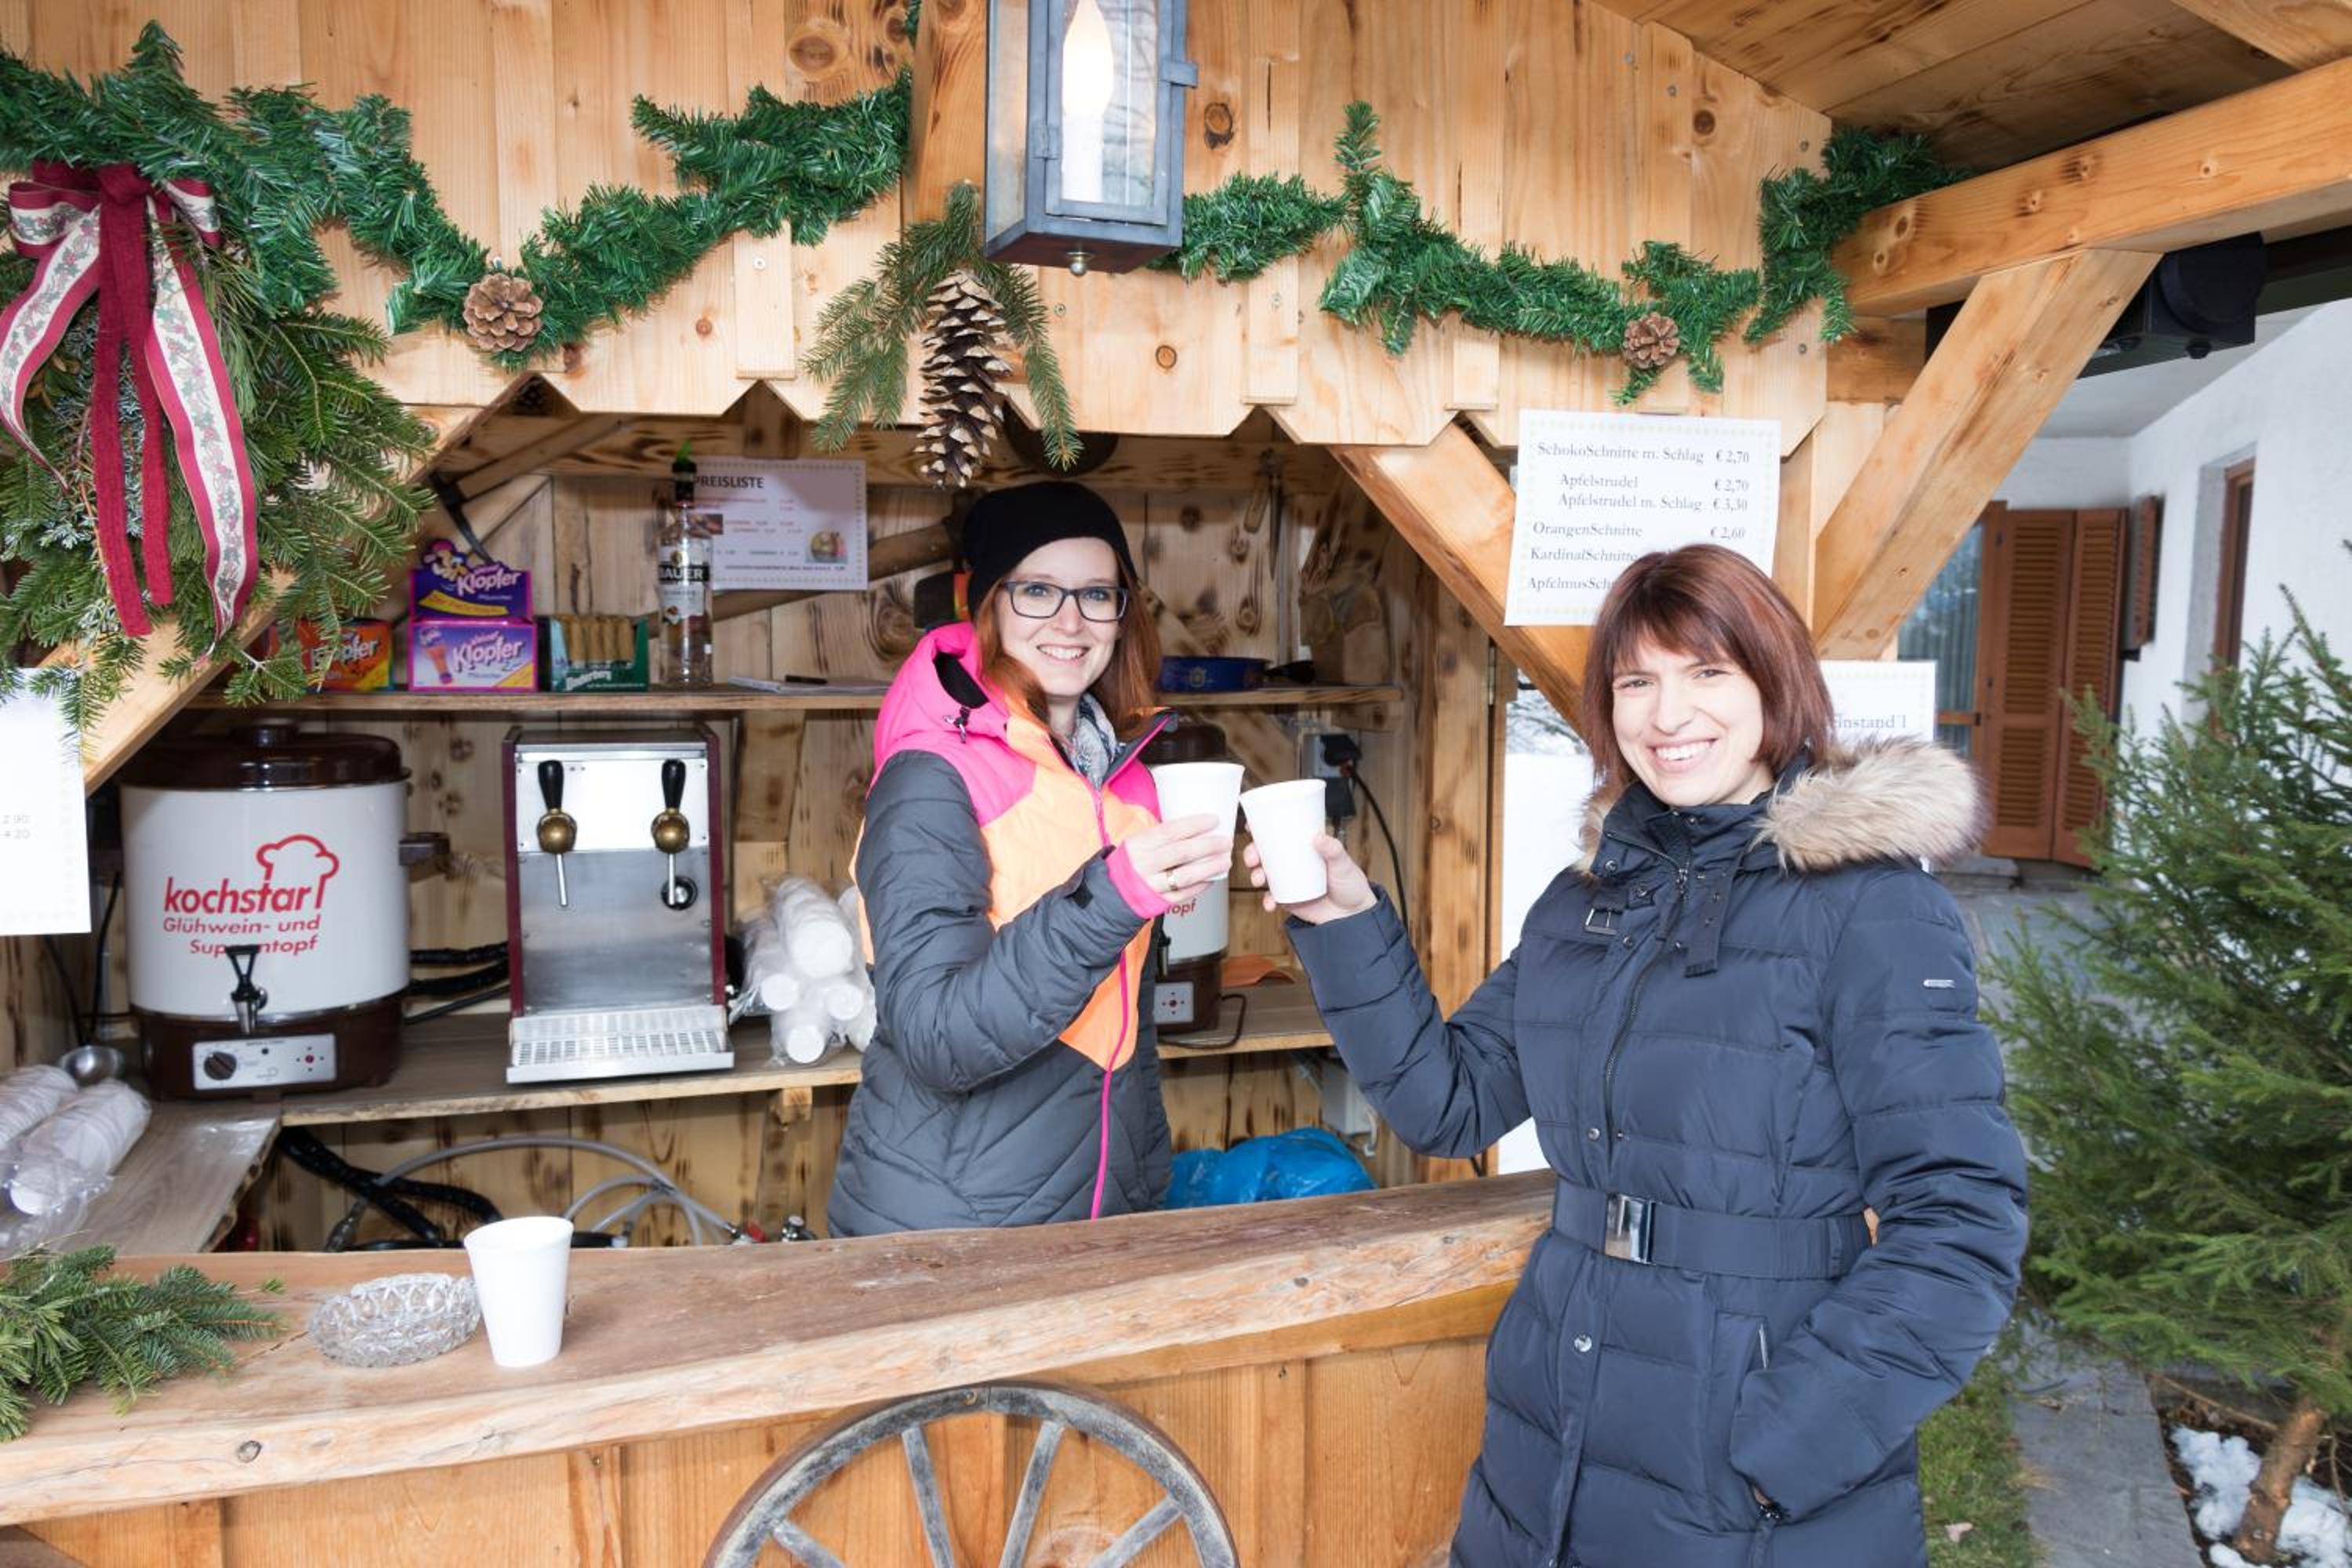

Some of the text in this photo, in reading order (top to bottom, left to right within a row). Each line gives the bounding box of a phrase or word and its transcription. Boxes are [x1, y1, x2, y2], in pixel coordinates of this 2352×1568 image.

[1537, 441, 1750, 464] SchokoSchnitte m. Schlag € 2,70
[1560, 473, 1750, 493] Apfelstrudel € 2,70
[1558, 492, 1637, 510] Apfelstrudel
[1640, 499, 1657, 509] m.
[1661, 498, 1702, 512] Schlag
[1532, 521, 1643, 539] OrangenSchnitte
[1720, 526, 1746, 540] 2,60
[457, 568, 521, 596] Klopfer
[452, 635, 523, 673] Klopfer
[163, 877, 310, 913] kochstar
[162, 914, 321, 934] Glühwein- und
[189, 935, 318, 958] Supntopf
